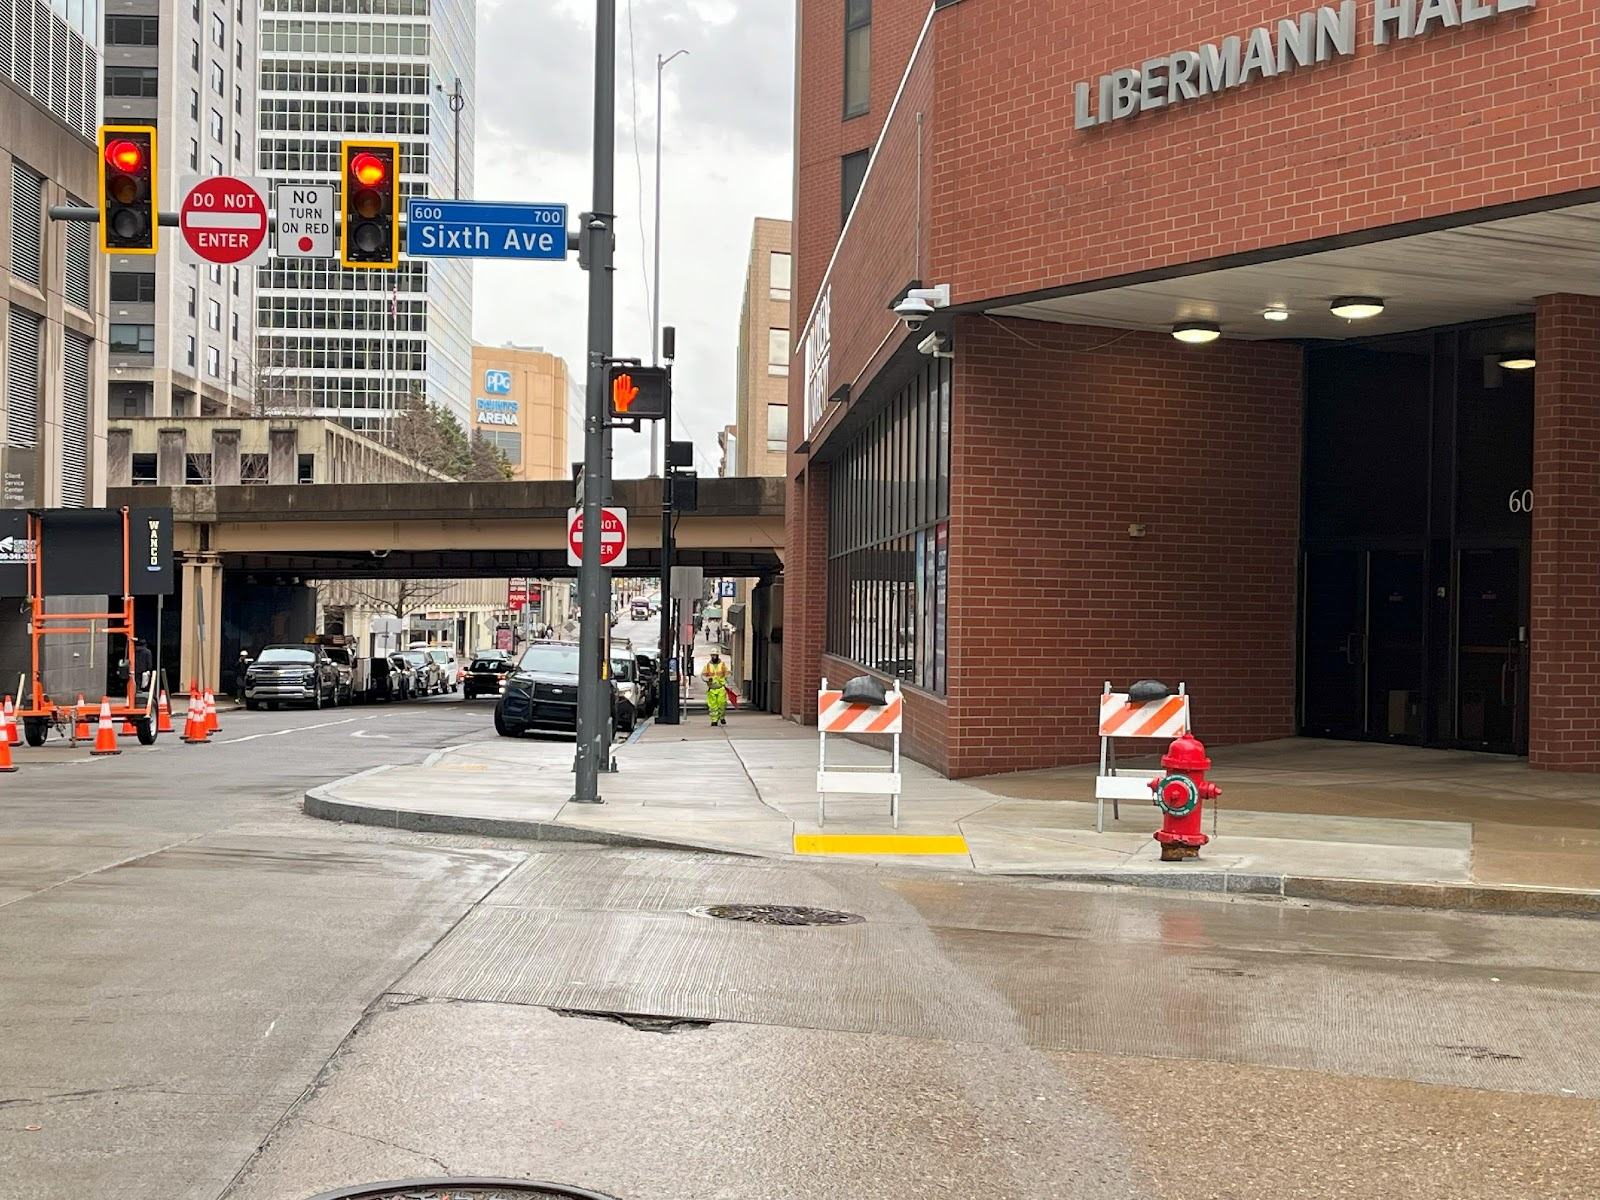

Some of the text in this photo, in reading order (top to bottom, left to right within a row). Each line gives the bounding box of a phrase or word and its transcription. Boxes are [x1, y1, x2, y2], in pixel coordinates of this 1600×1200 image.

[1074, 0, 1356, 130] LIBERMANN
[193, 193, 255, 208] DO NOT
[293, 190, 317, 204] NO
[289, 208, 322, 219] TURN
[414, 207, 560, 223] 600 700
[282, 222, 329, 233] ON RED
[198, 233, 248, 248] ENTER
[422, 225, 553, 252] Sixth Ave
[487, 372, 511, 391] PPG
[477, 411, 518, 426] ARENA
[149, 520, 160, 566] WANCO
